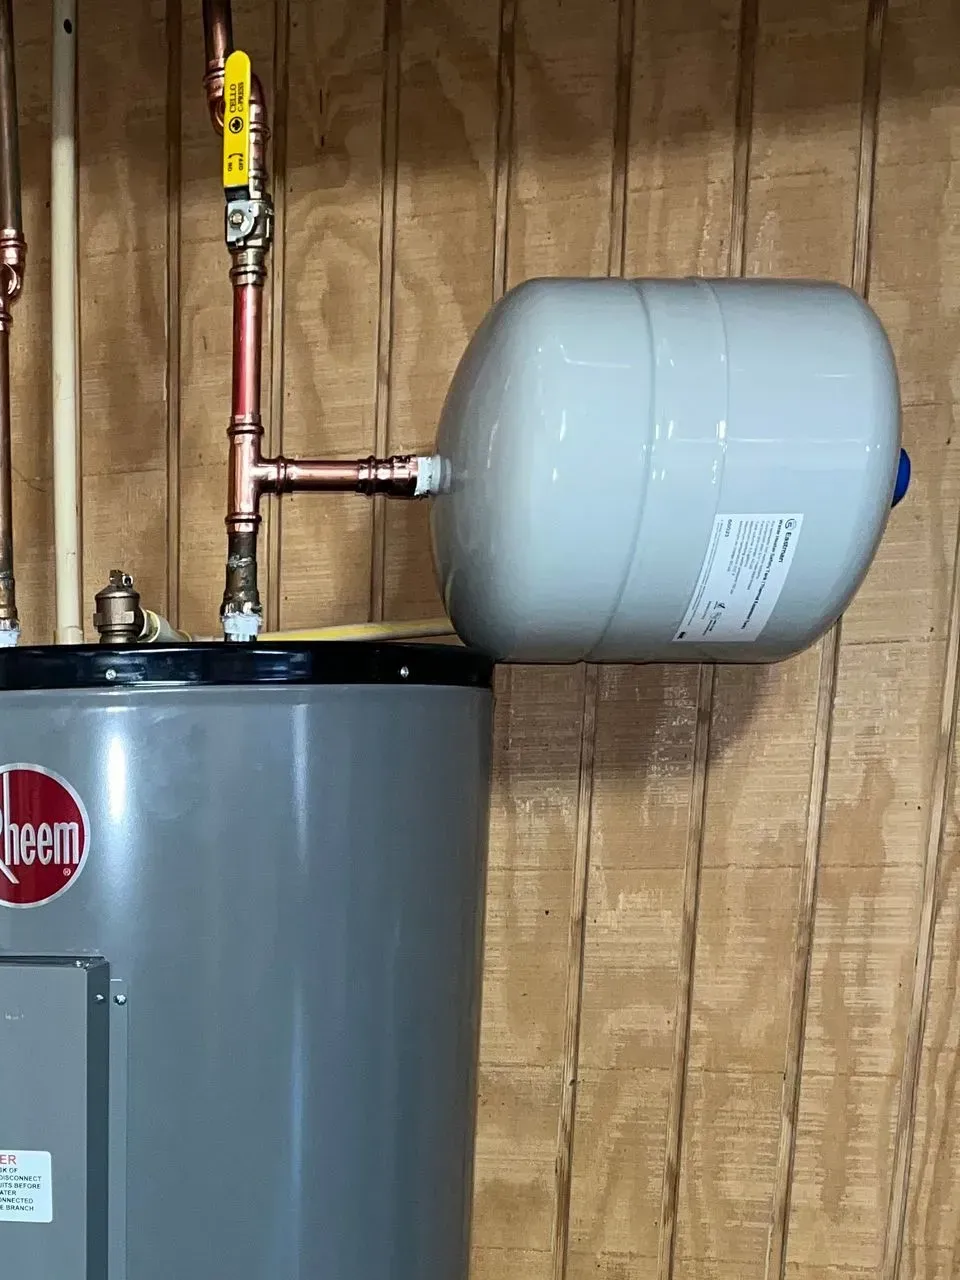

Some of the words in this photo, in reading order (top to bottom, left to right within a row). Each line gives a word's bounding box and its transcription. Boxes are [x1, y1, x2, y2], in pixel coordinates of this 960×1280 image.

[229, 83, 237, 113] CELLO
[228, 162, 232, 172] ON
[778, 532, 792, 563] Eastman
